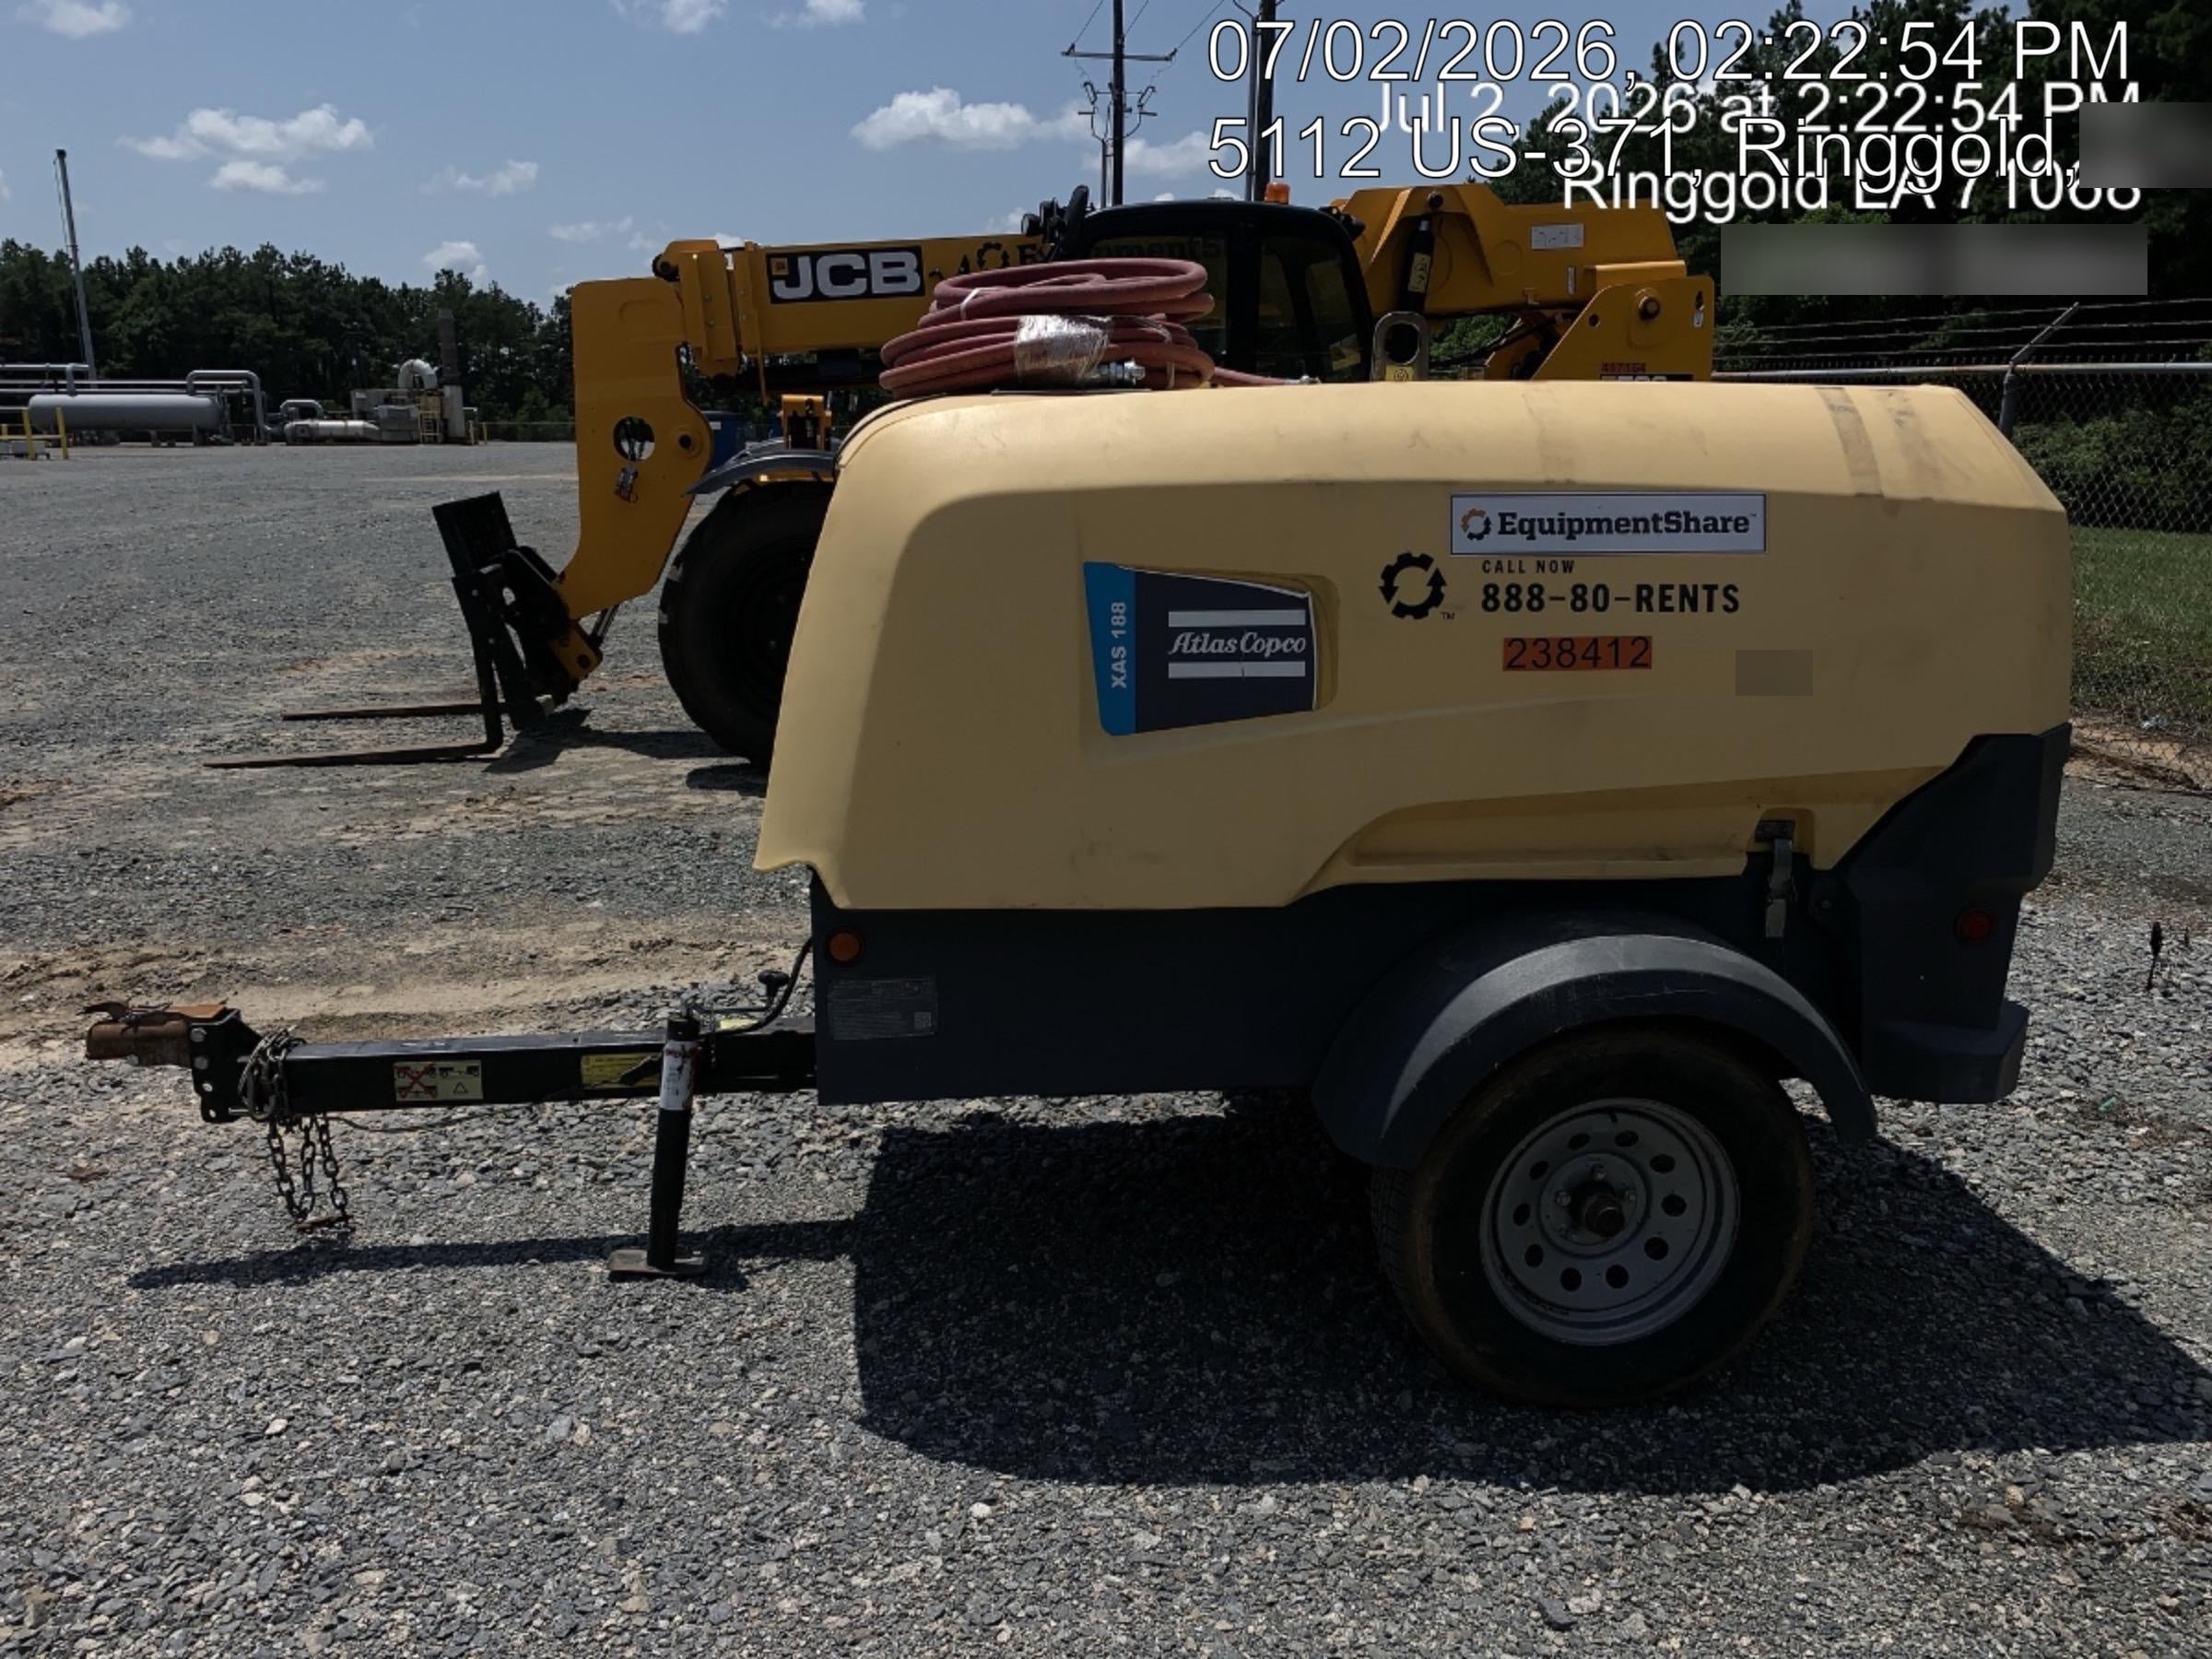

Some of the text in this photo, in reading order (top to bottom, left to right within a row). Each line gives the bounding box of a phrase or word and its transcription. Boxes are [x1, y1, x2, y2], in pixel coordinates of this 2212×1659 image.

[773, 251, 921, 300] JCB
[1498, 512, 1749, 540] EquipmentShare
[1482, 560, 1574, 574] CALL NOW
[1481, 582, 1740, 614] 888-80-RENTS
[1112, 602, 1127, 688] XAS 188
[1168, 632, 1306, 658] Atlas Copco
[1505, 637, 1650, 669] 238412
